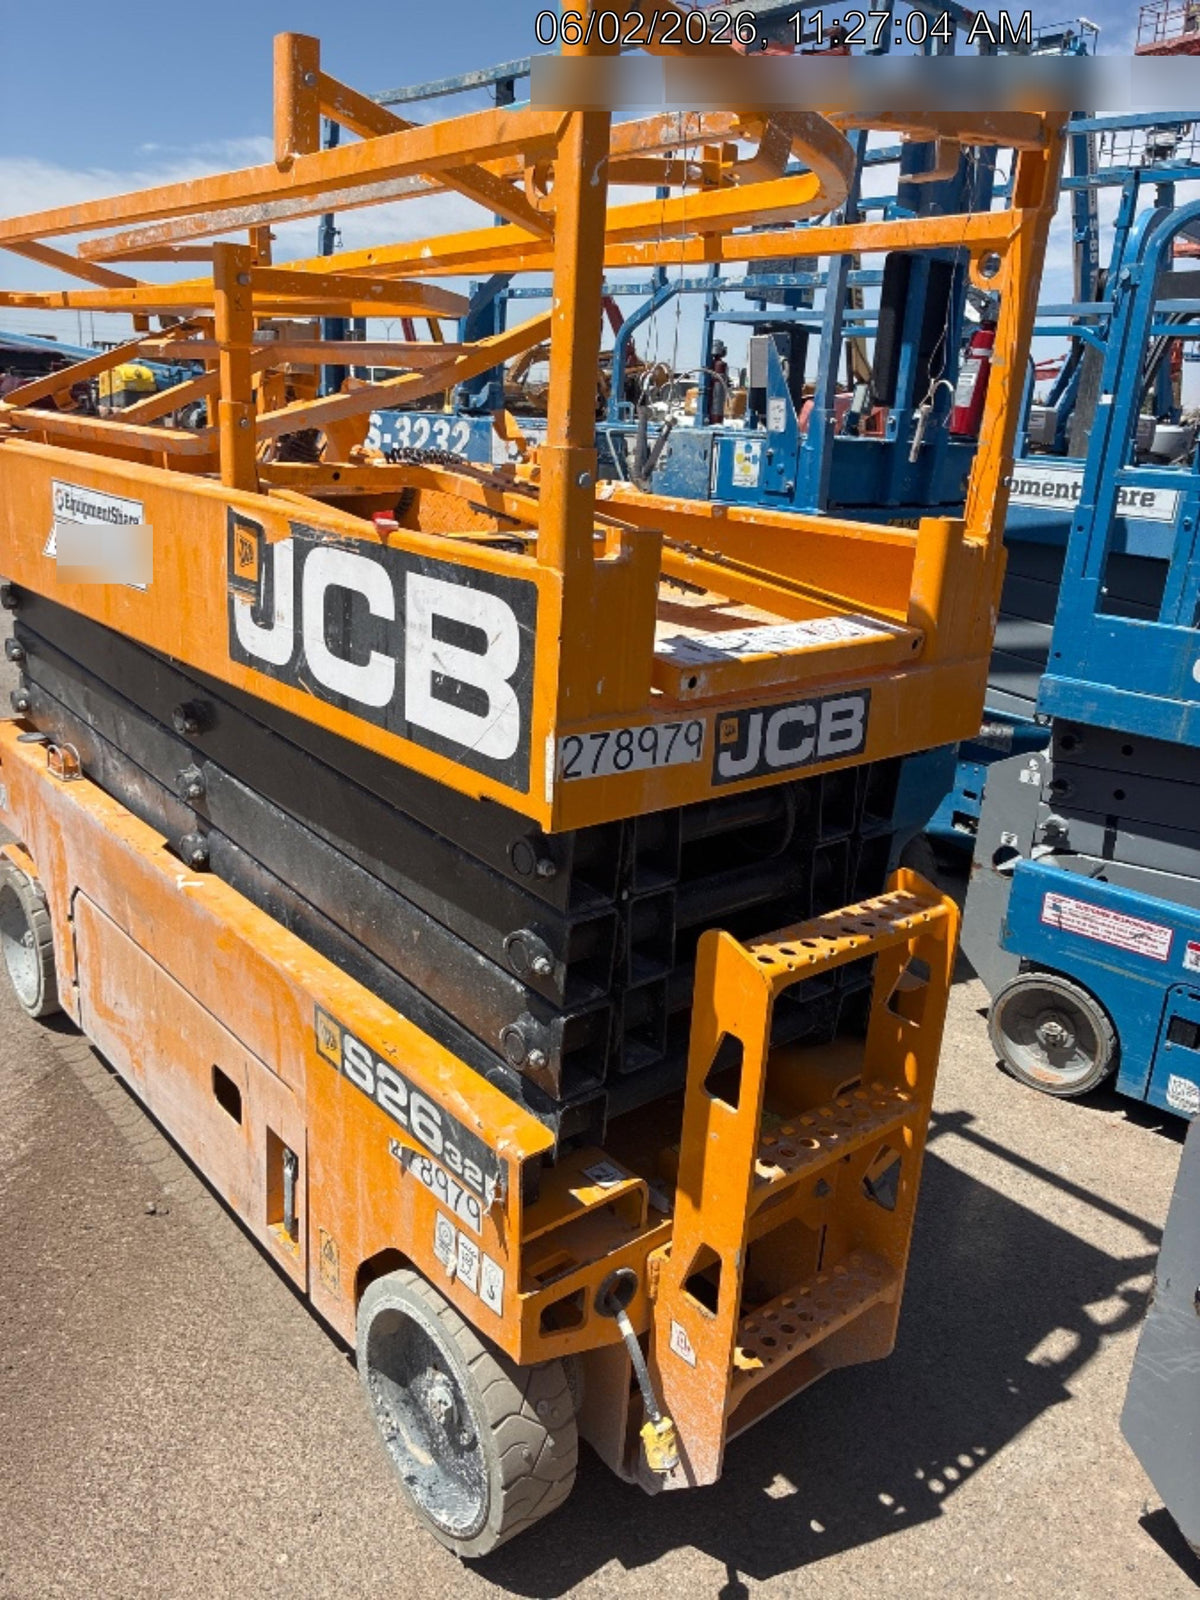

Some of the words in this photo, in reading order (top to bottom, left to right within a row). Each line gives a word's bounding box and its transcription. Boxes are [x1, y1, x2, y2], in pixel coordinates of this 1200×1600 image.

[234, 537, 520, 760] JCB
[562, 719, 702, 779] 278979
[717, 696, 866, 777] JCB
